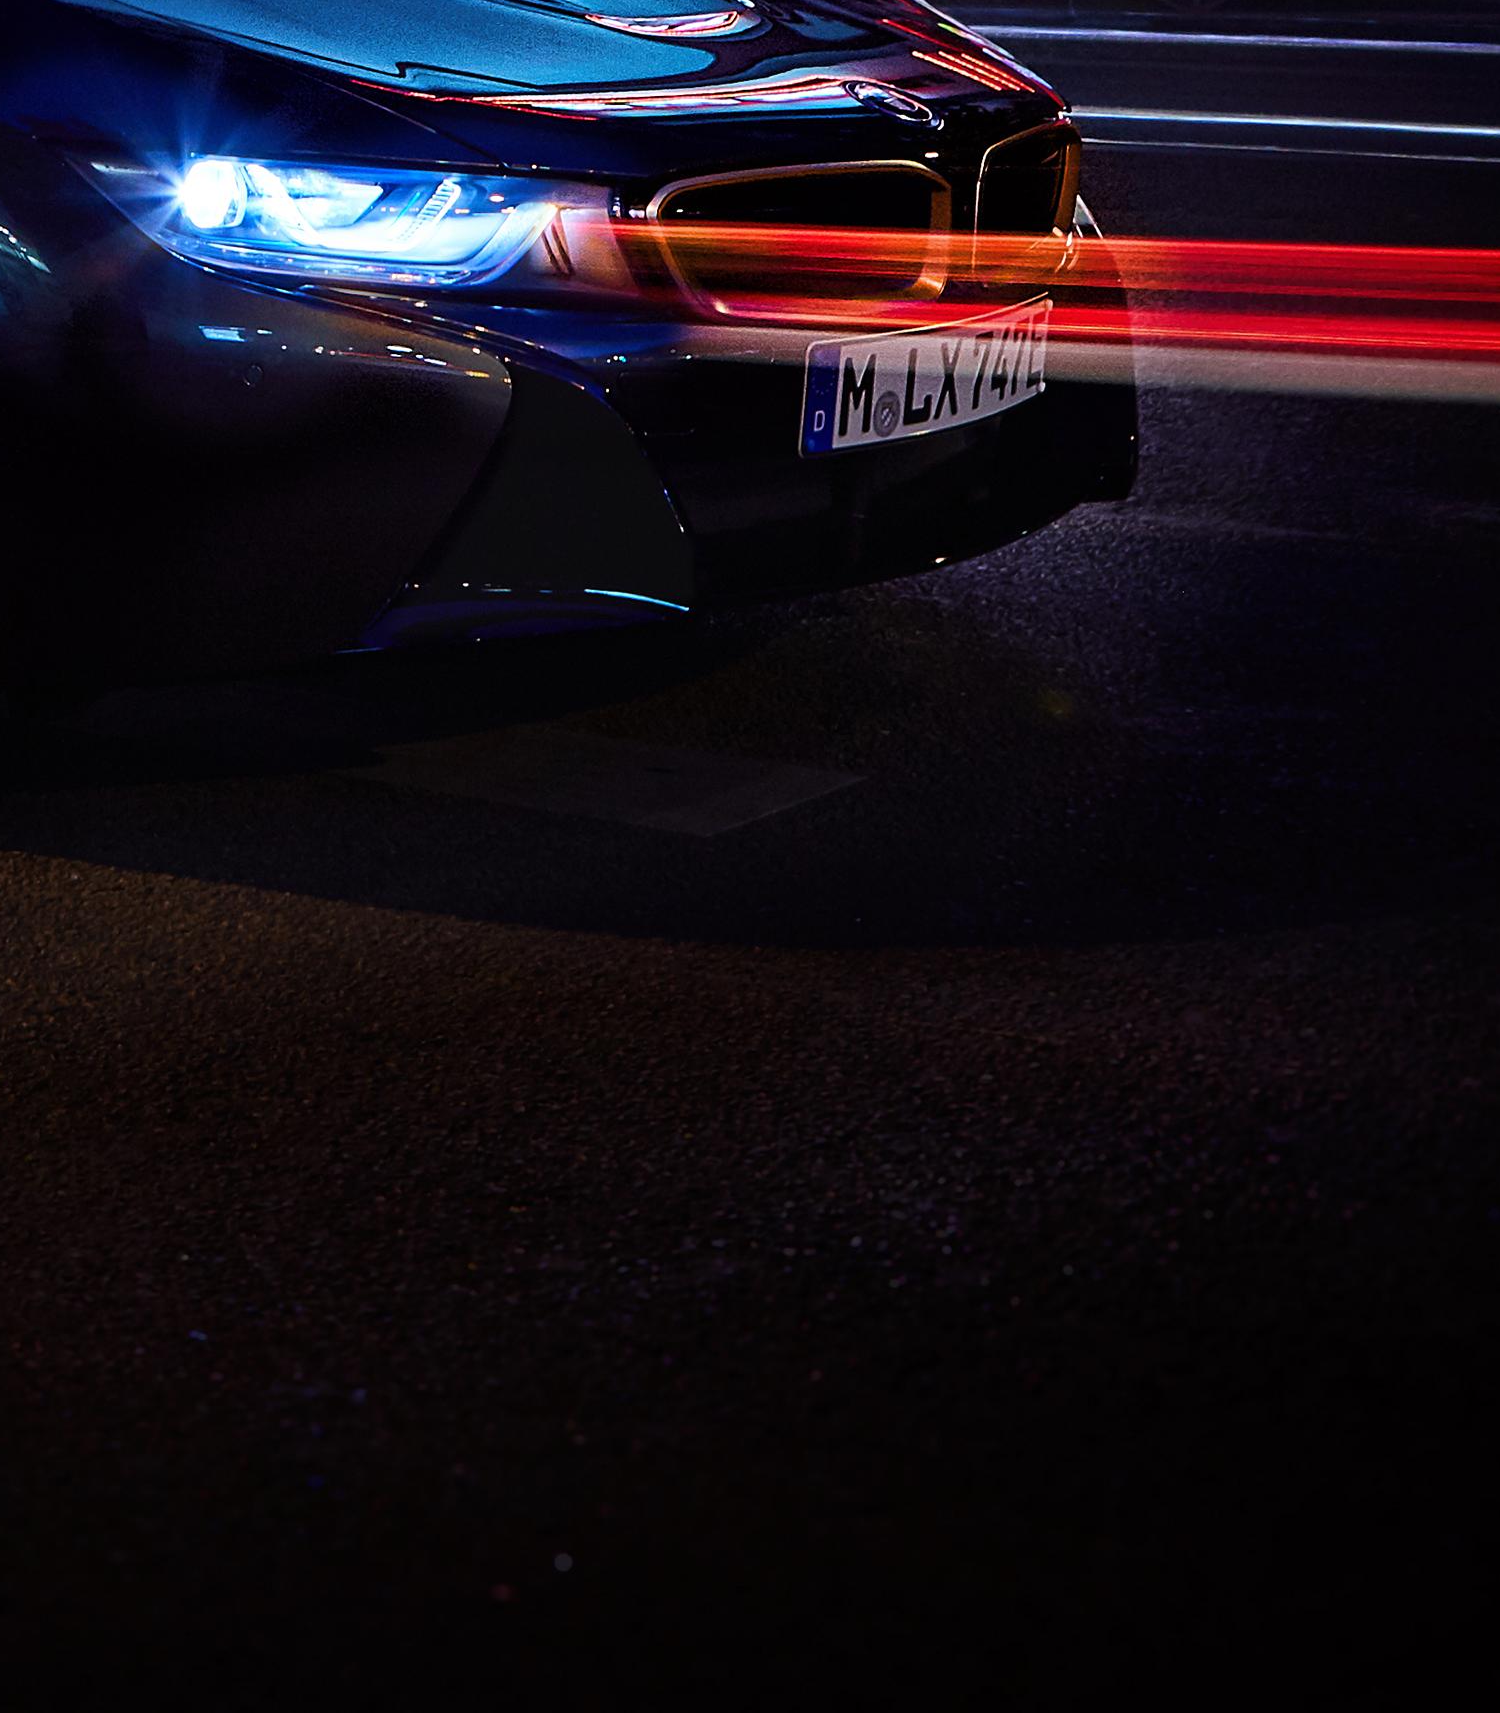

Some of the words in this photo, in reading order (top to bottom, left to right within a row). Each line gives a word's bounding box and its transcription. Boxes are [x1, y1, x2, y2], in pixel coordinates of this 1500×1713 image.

[838, 353, 877, 436] M
[903, 338, 963, 425] LX
[813, 409, 825, 432] D
